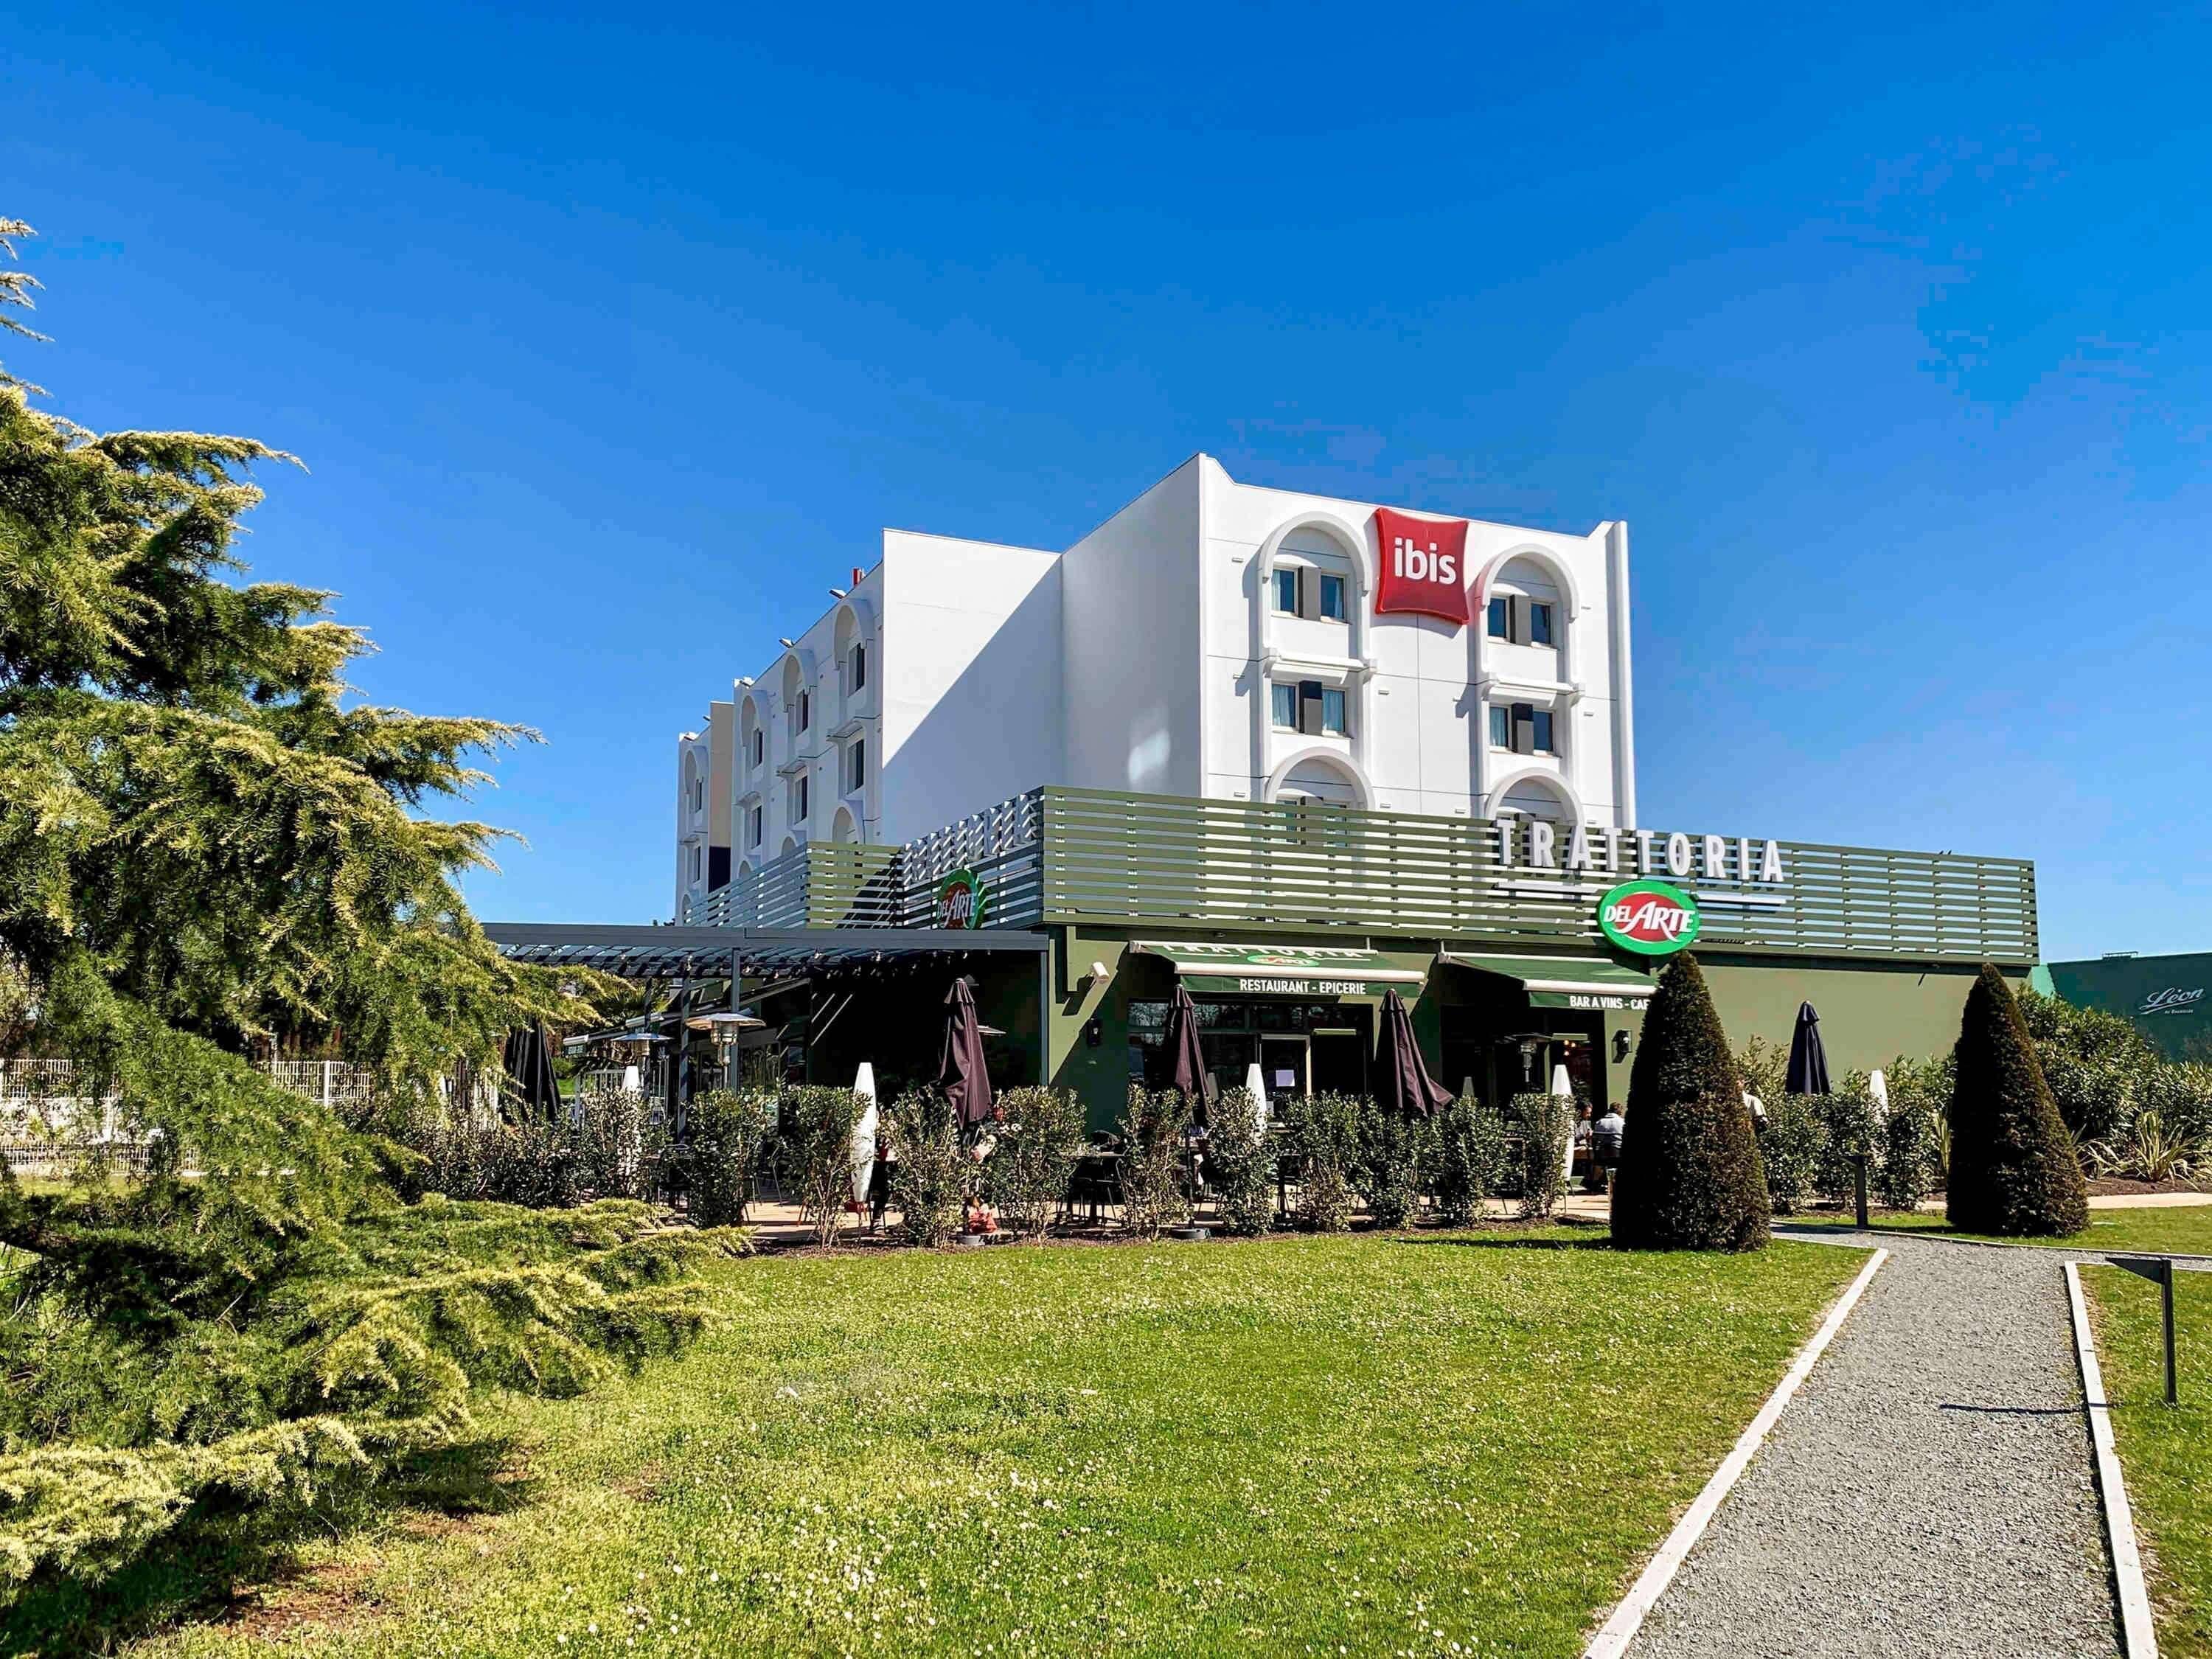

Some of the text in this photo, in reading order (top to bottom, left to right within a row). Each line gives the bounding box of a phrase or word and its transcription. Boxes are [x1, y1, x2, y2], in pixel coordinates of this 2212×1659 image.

[1394, 538, 1457, 585] ibis
[1495, 819, 1784, 883] TRATTORIA
[1239, 978, 1309, 993] RESTAURANT
[1319, 982, 1366, 995] EPICERIE
[1570, 995, 1590, 1007] BAR
[1591, 997, 1597, 1008] A
[1600, 997, 1623, 1009] VINS
[1630, 999, 1652, 1010] CAF
